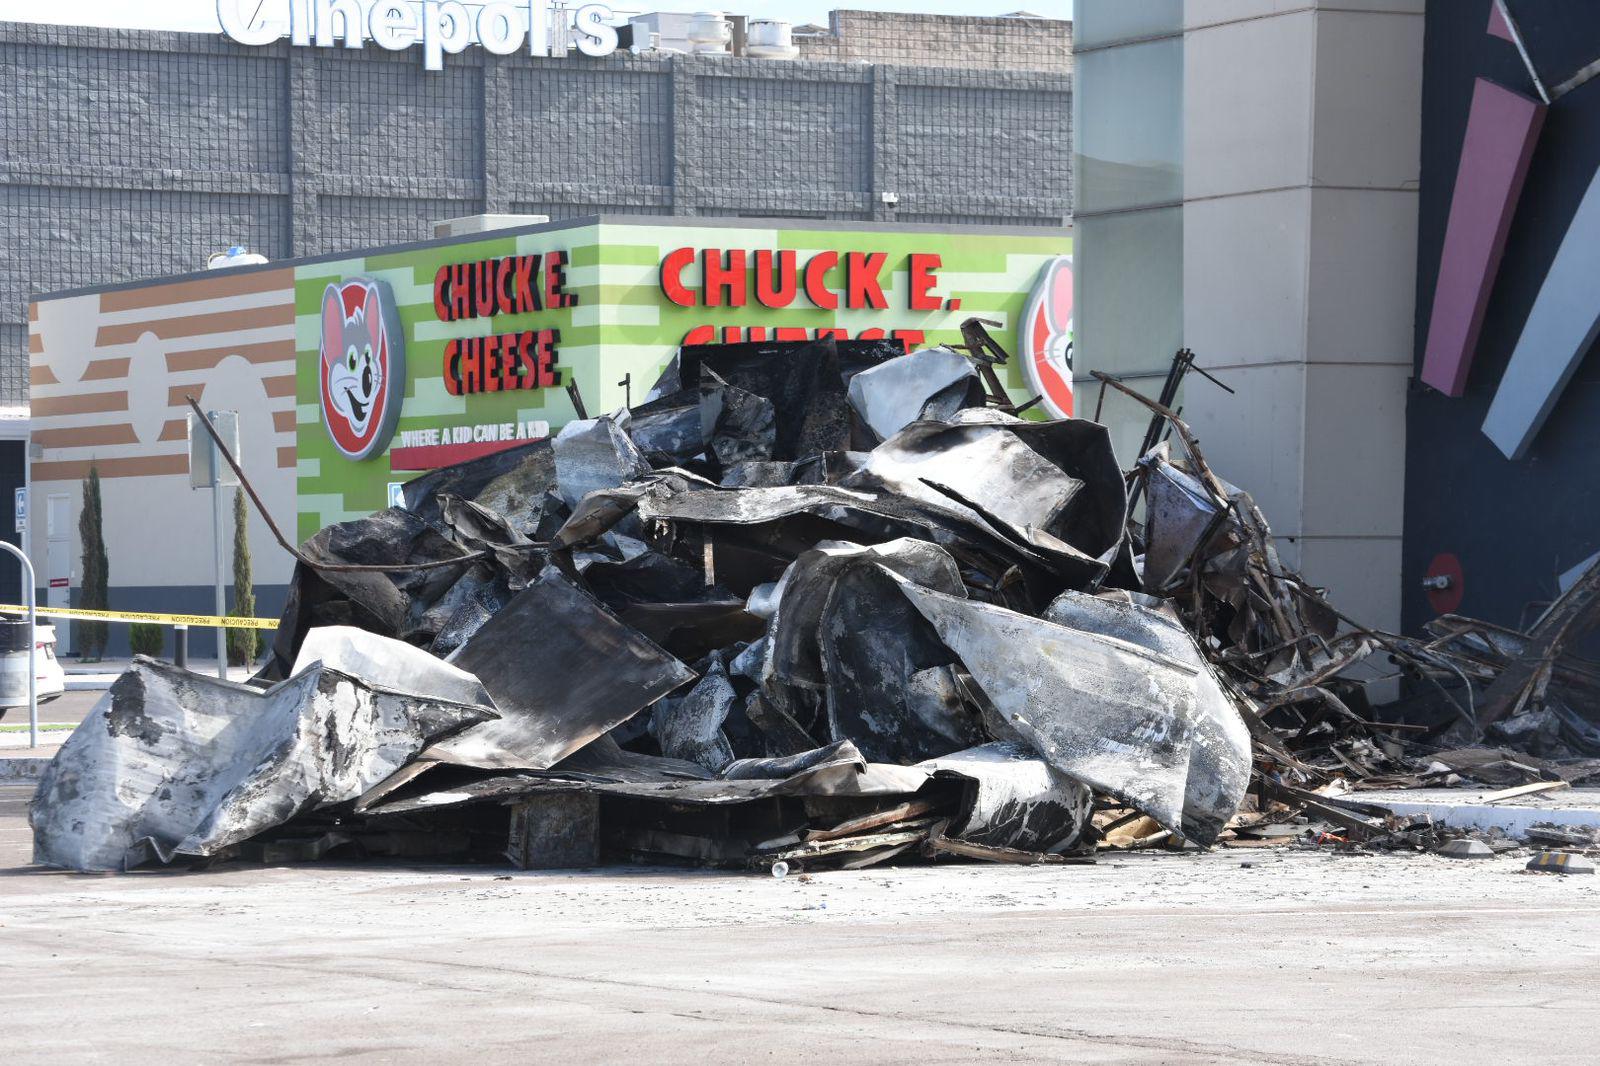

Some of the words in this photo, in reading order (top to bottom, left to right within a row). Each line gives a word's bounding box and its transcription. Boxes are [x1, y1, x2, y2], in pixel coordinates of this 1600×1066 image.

[434, 254, 542, 322] CHUCK
[545, 251, 579, 309] E.
[660, 247, 889, 310] CHUCK
[909, 254, 961, 310] E.
[443, 329, 561, 396] CHEESE
[401, 429, 439, 448] WHERE
[441, 428, 450, 445] A
[453, 426, 472, 443] KID
[474, 424, 498, 442] CAN
[500, 423, 514, 440] BE
[517, 422, 526, 439] A
[528, 420, 550, 438] KID
